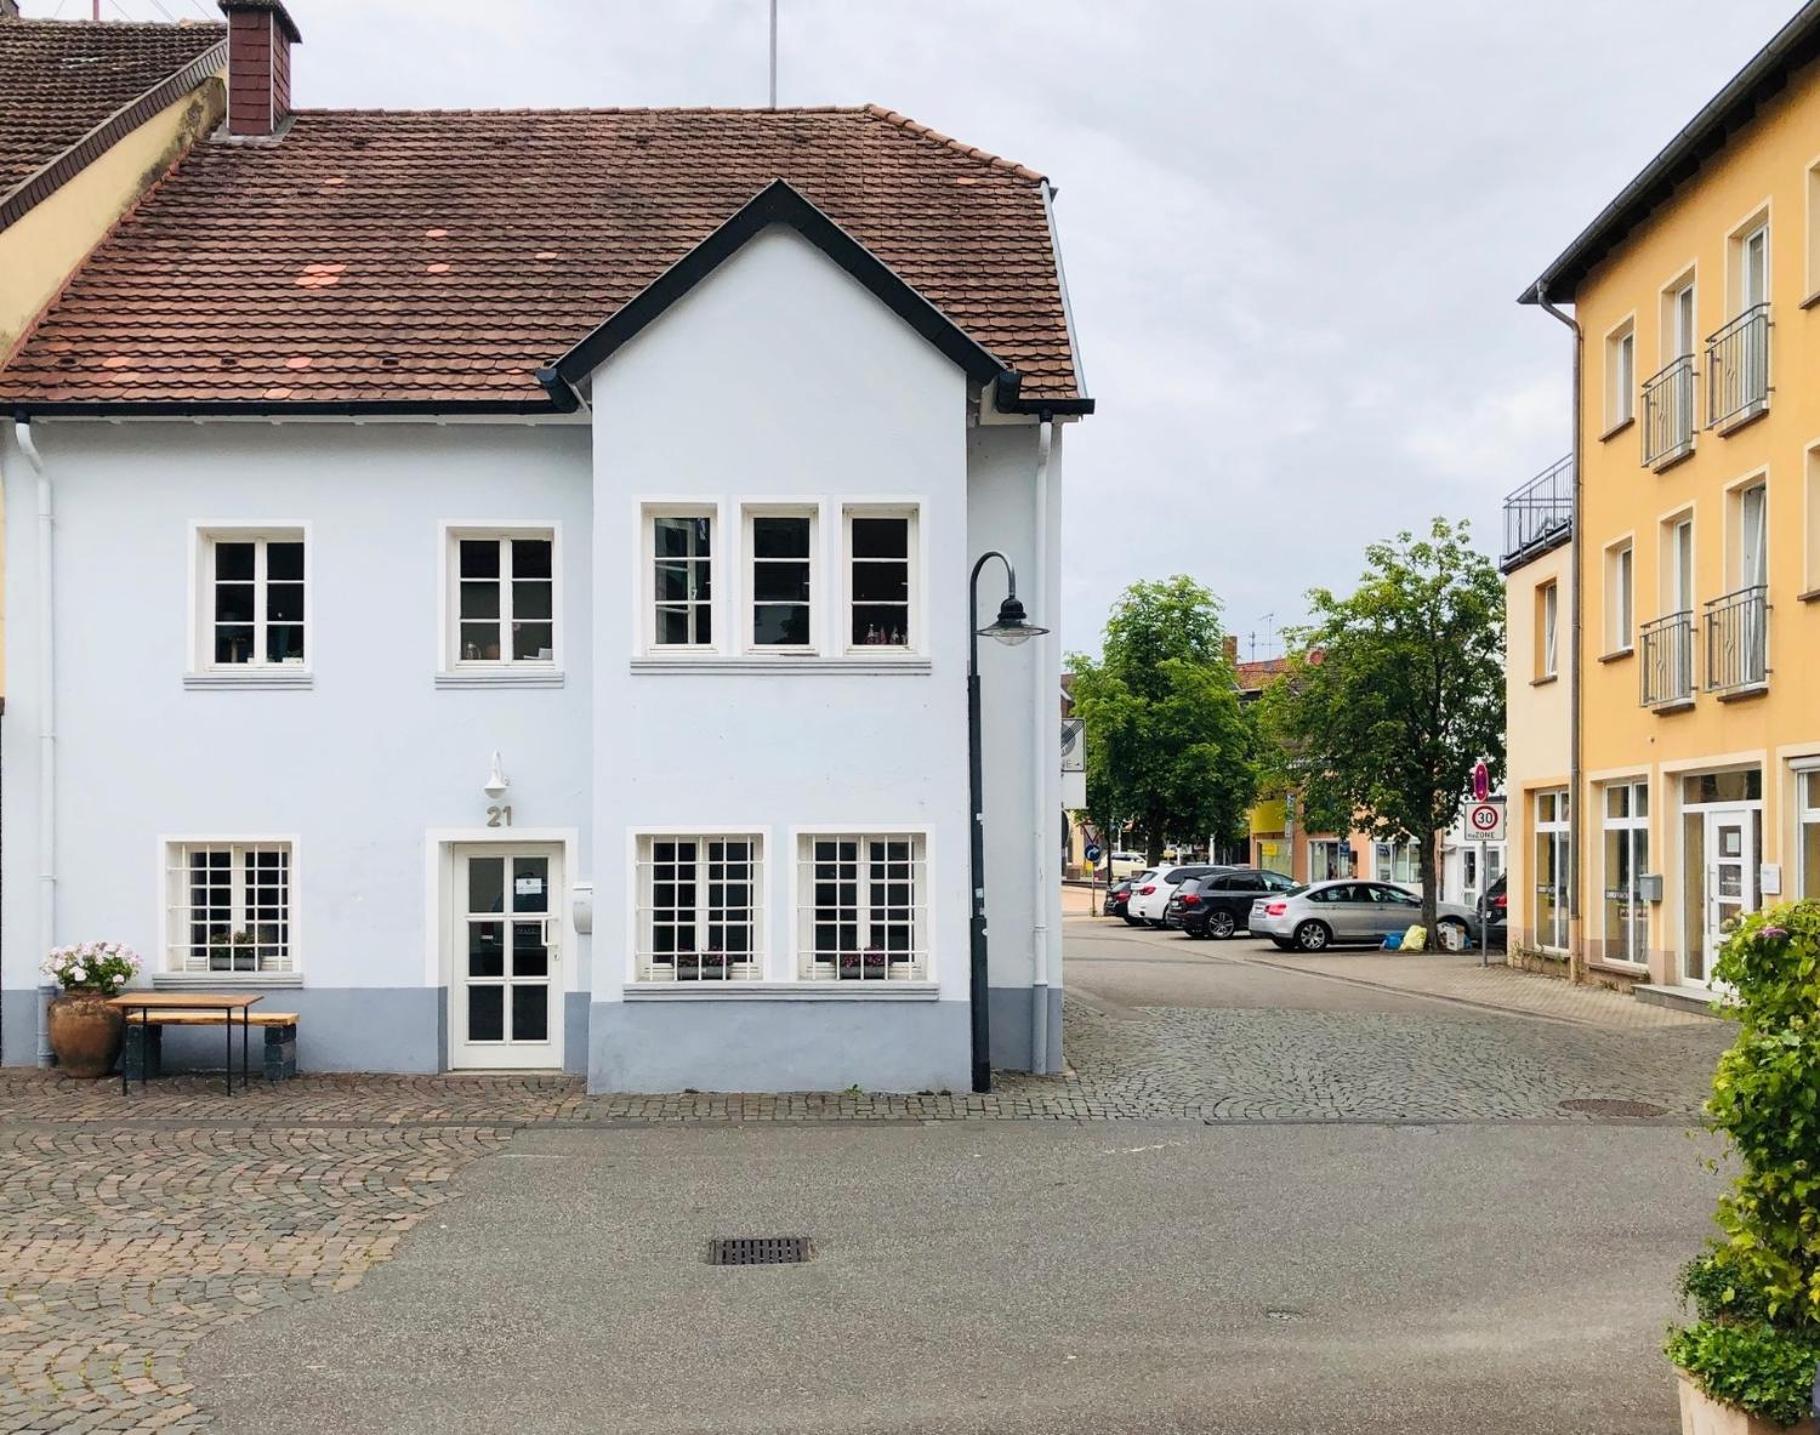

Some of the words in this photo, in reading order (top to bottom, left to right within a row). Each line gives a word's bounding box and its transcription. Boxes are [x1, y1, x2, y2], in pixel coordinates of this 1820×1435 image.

[487, 805, 512, 828] 21
[1477, 812, 1493, 824] 30
[1475, 831, 1495, 839] ZONE
